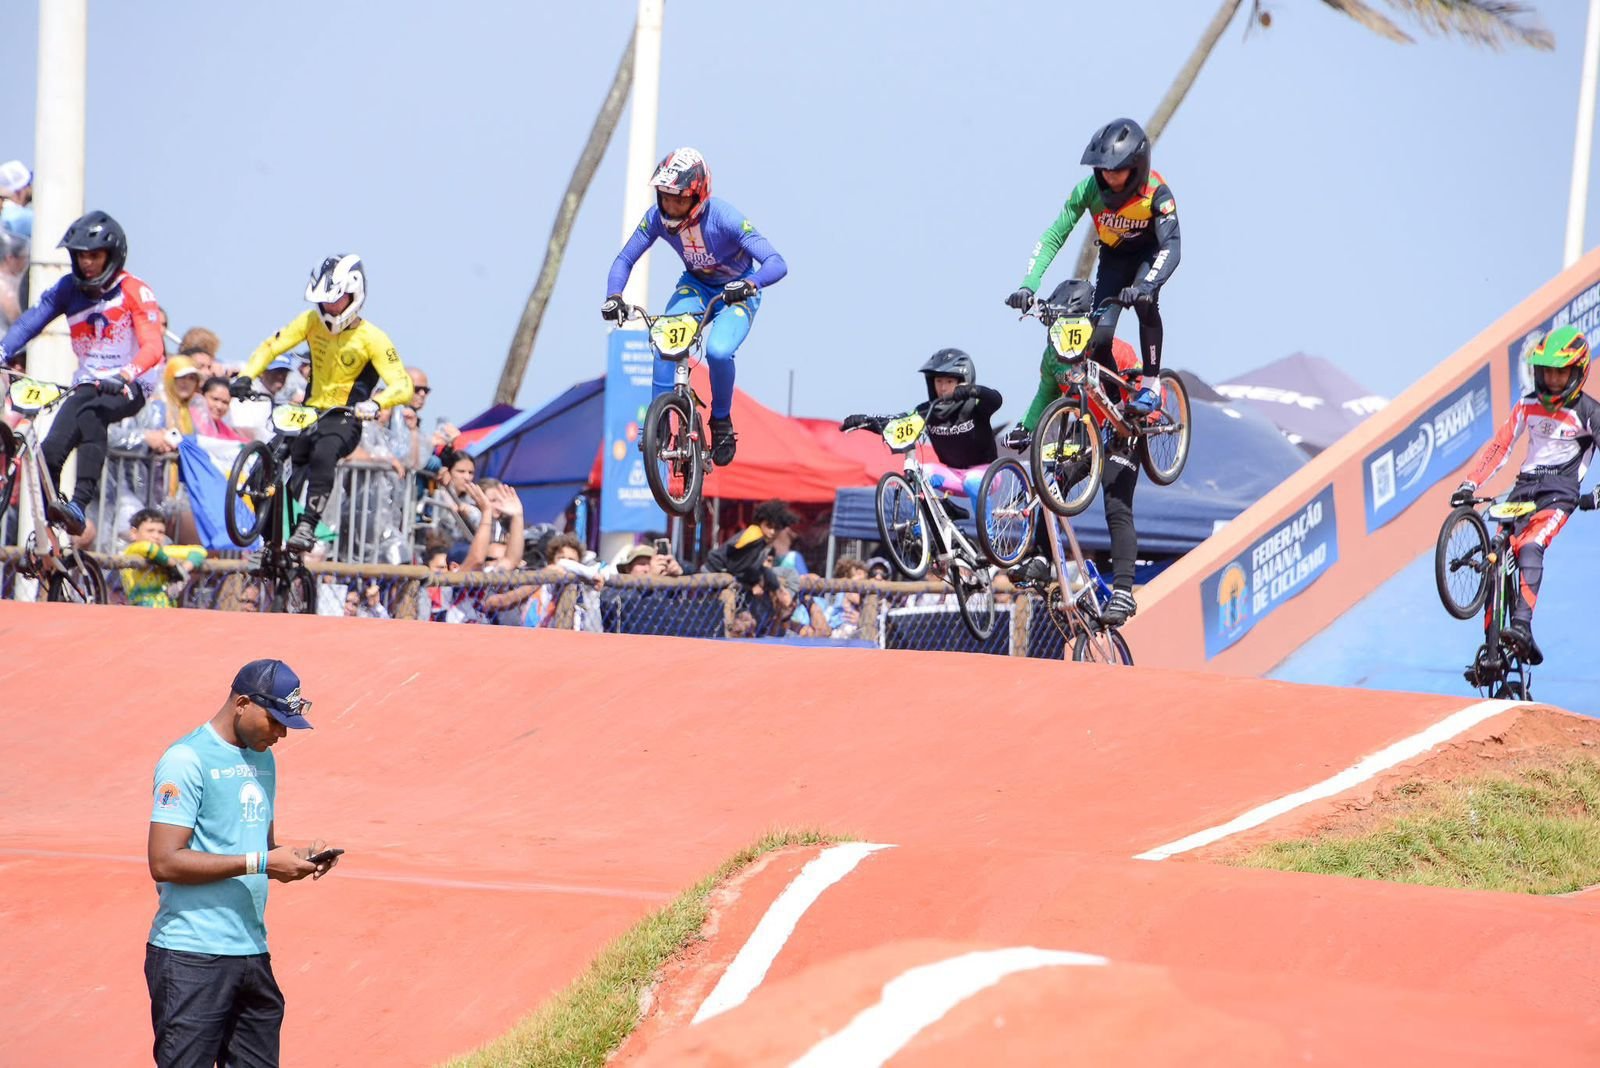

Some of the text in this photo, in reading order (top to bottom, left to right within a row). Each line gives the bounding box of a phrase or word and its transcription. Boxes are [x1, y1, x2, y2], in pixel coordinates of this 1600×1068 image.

[669, 327, 687, 345] 37
[1068, 328, 1082, 346] 15
[1089, 361, 1099, 379] 15
[290, 412, 307, 424] 18
[896, 424, 914, 440] 36
[1252, 500, 1323, 571] FEDERAÇÃO
[1252, 541, 1302, 593] BAIANA
[1253, 542, 1327, 616] DE CICLISMO
